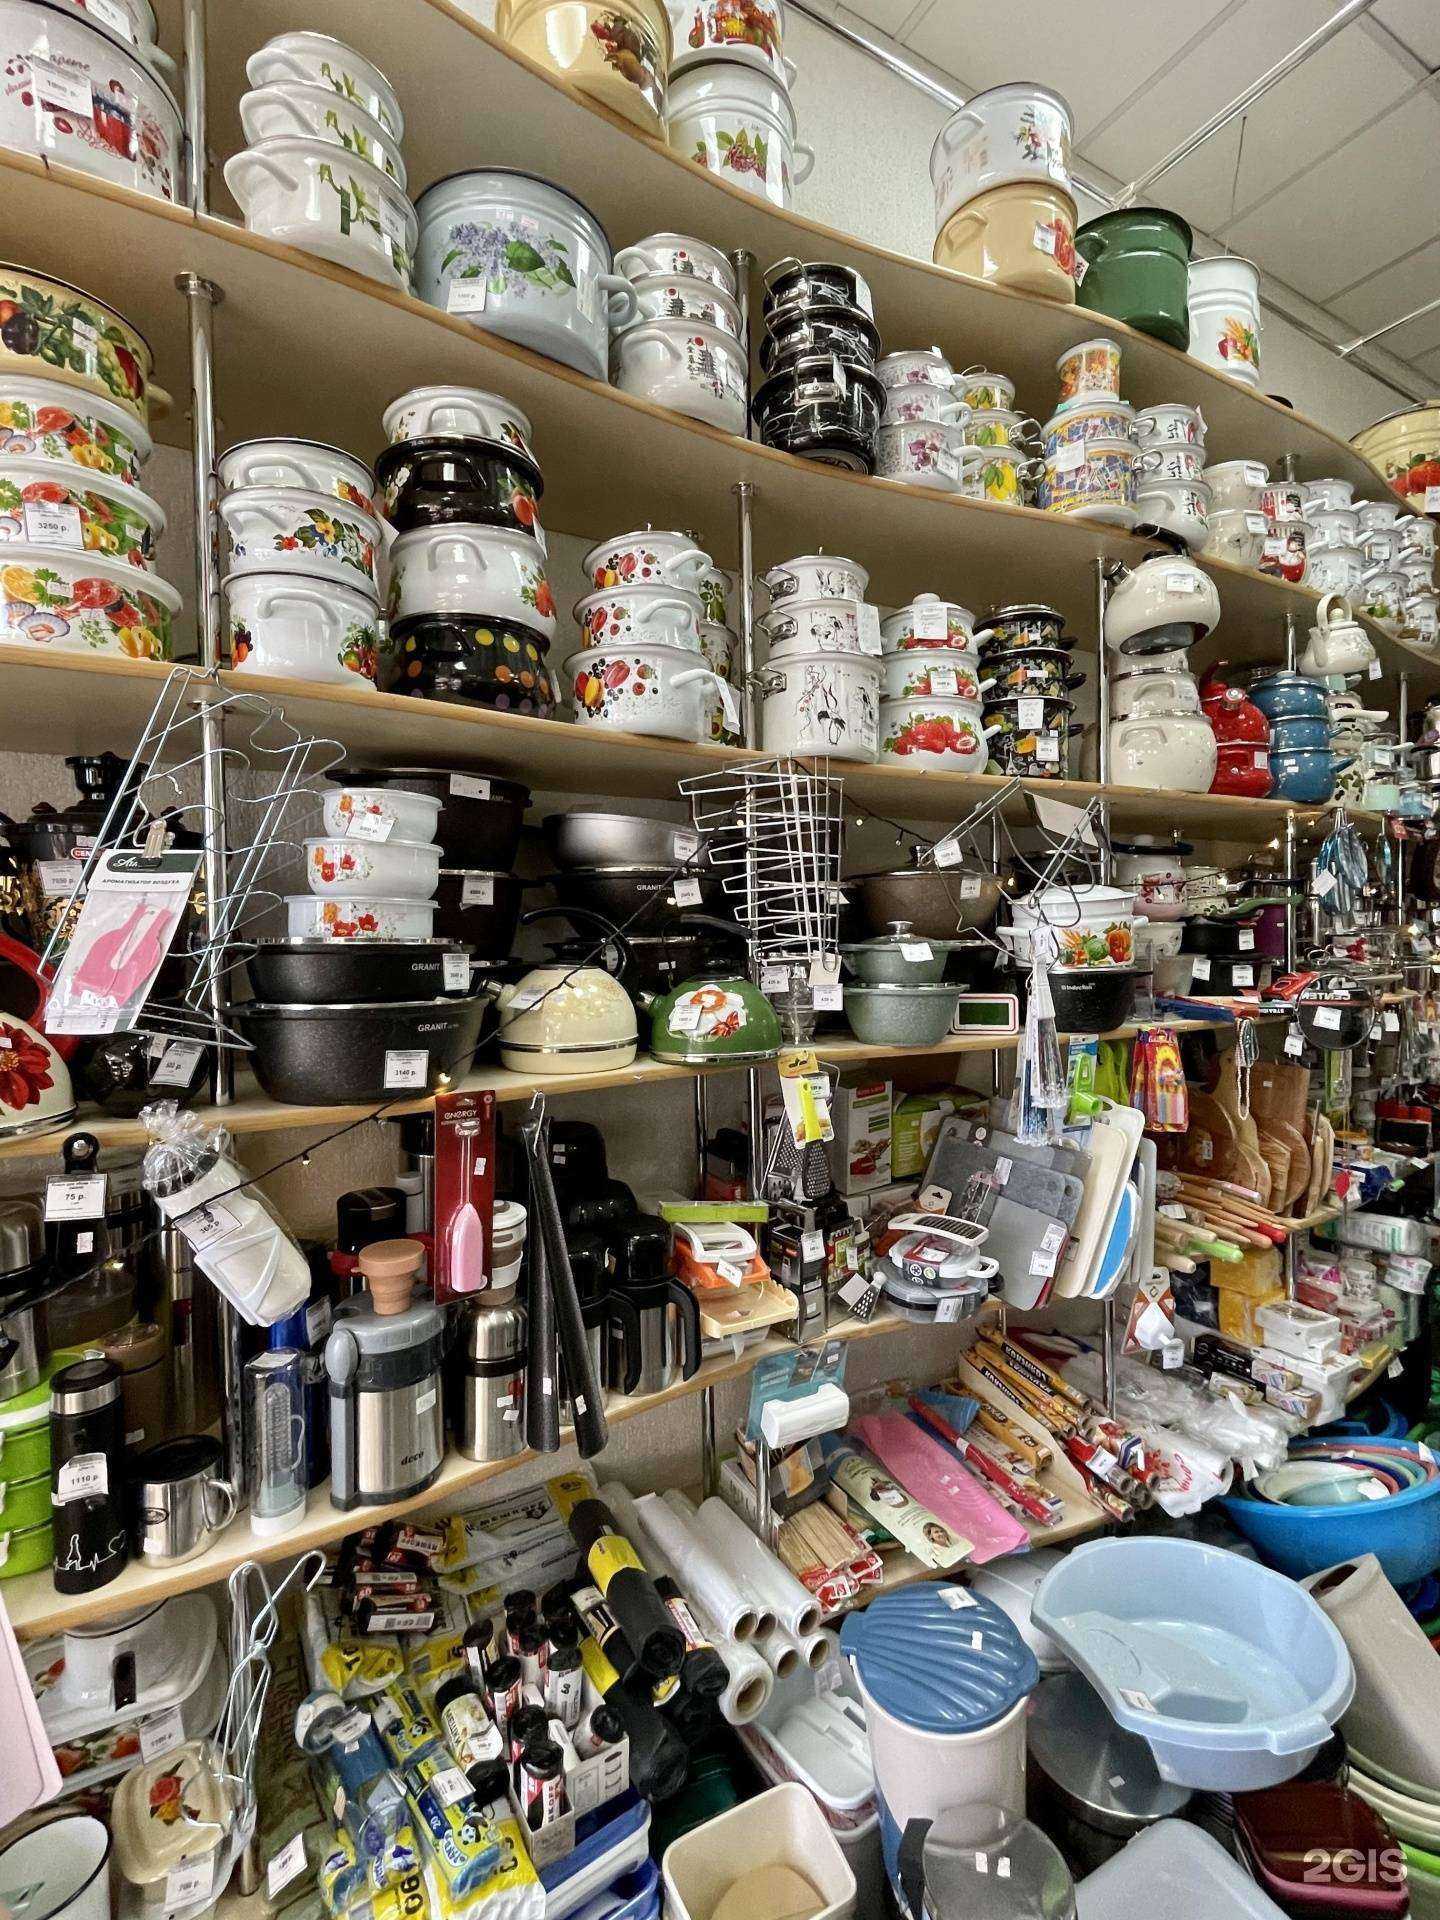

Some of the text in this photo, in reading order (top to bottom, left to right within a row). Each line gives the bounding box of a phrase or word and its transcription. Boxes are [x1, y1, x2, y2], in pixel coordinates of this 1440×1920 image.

[37, 522, 59, 530] 3250
[411, 962, 441, 971] GRANIT
[417, 1022, 448, 1032] GRANIT
[65, 1193, 76, 1201] 75
